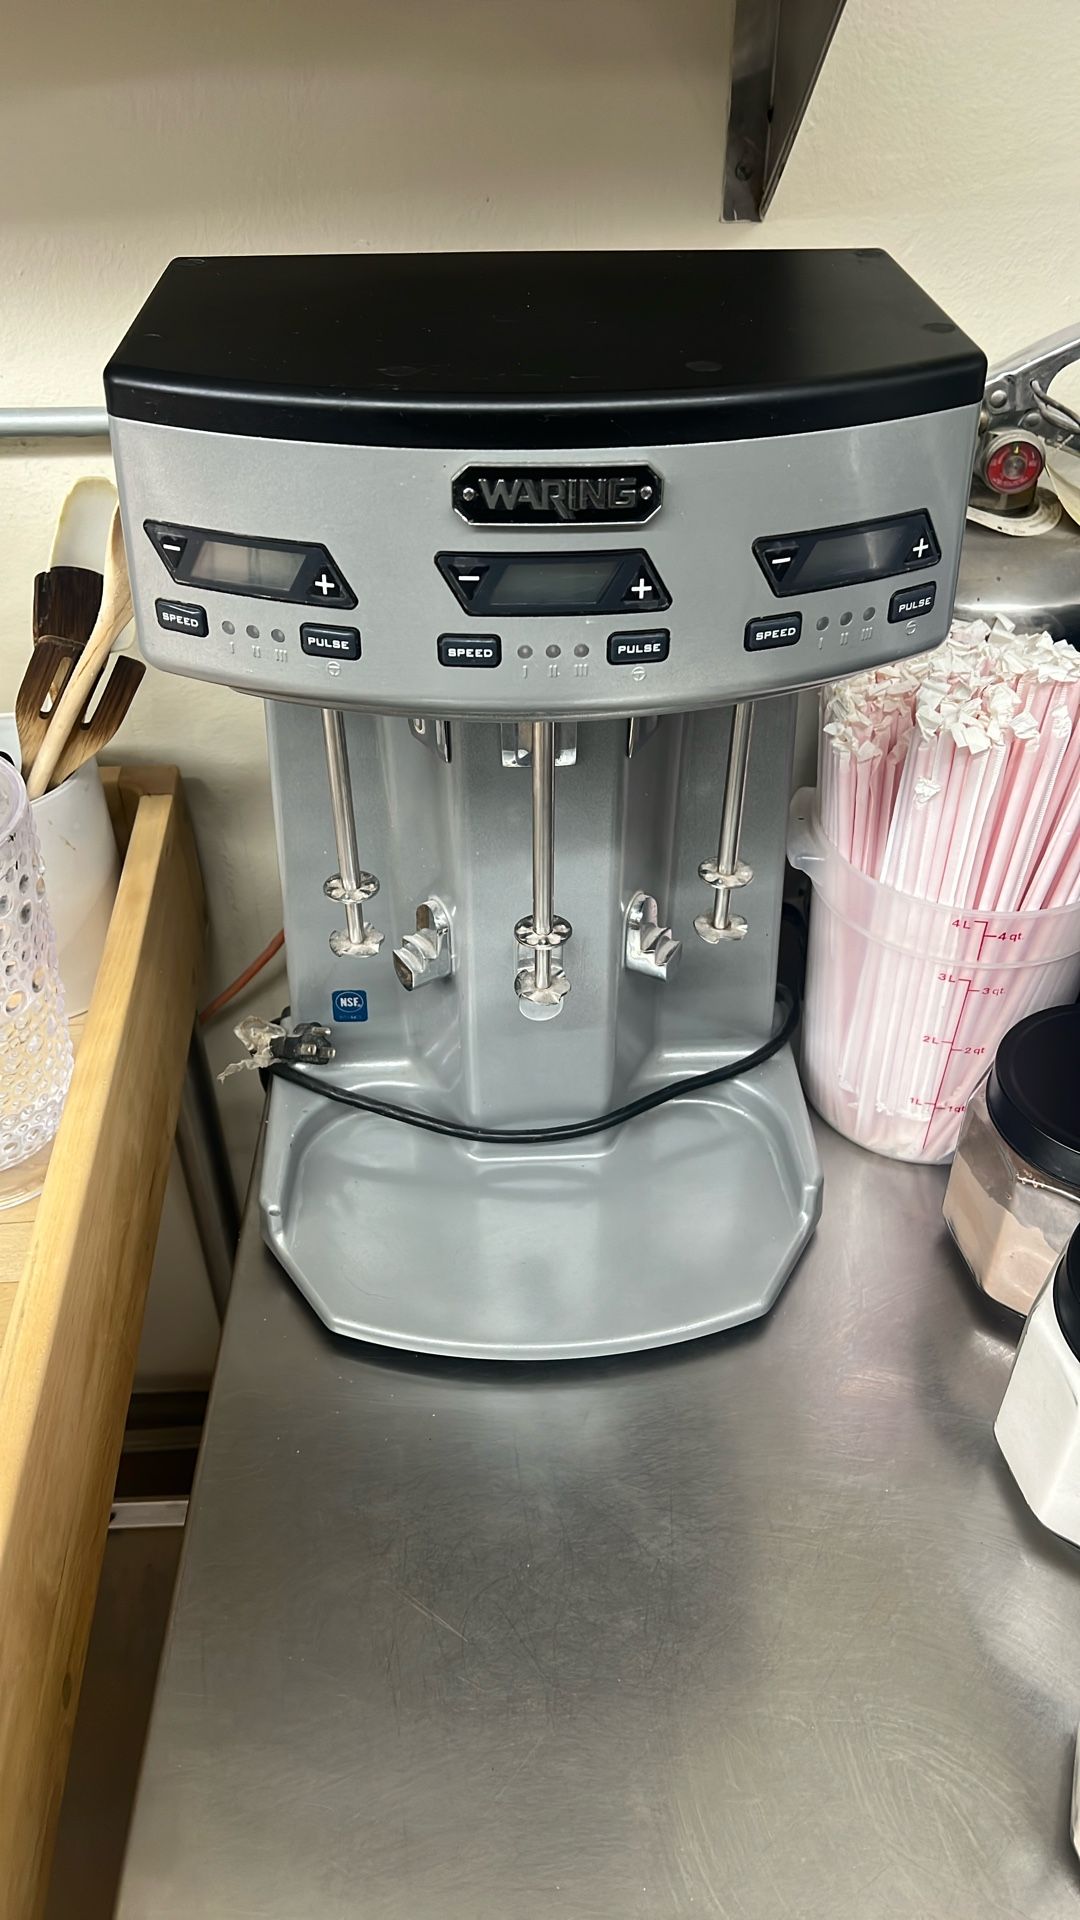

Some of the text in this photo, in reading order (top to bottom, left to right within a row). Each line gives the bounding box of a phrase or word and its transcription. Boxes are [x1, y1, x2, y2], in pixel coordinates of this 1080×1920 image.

[477, 477, 638, 520] WARING
[898, 597, 932, 613] PULSE
[162, 611, 200, 629] SPEED
[755, 627, 797, 641] SPEED
[307, 636, 350, 650] PULSE
[617, 643, 661, 654] PULSE
[447, 648, 493, 659] SPEED
[340, 997, 359, 1008] NSF
